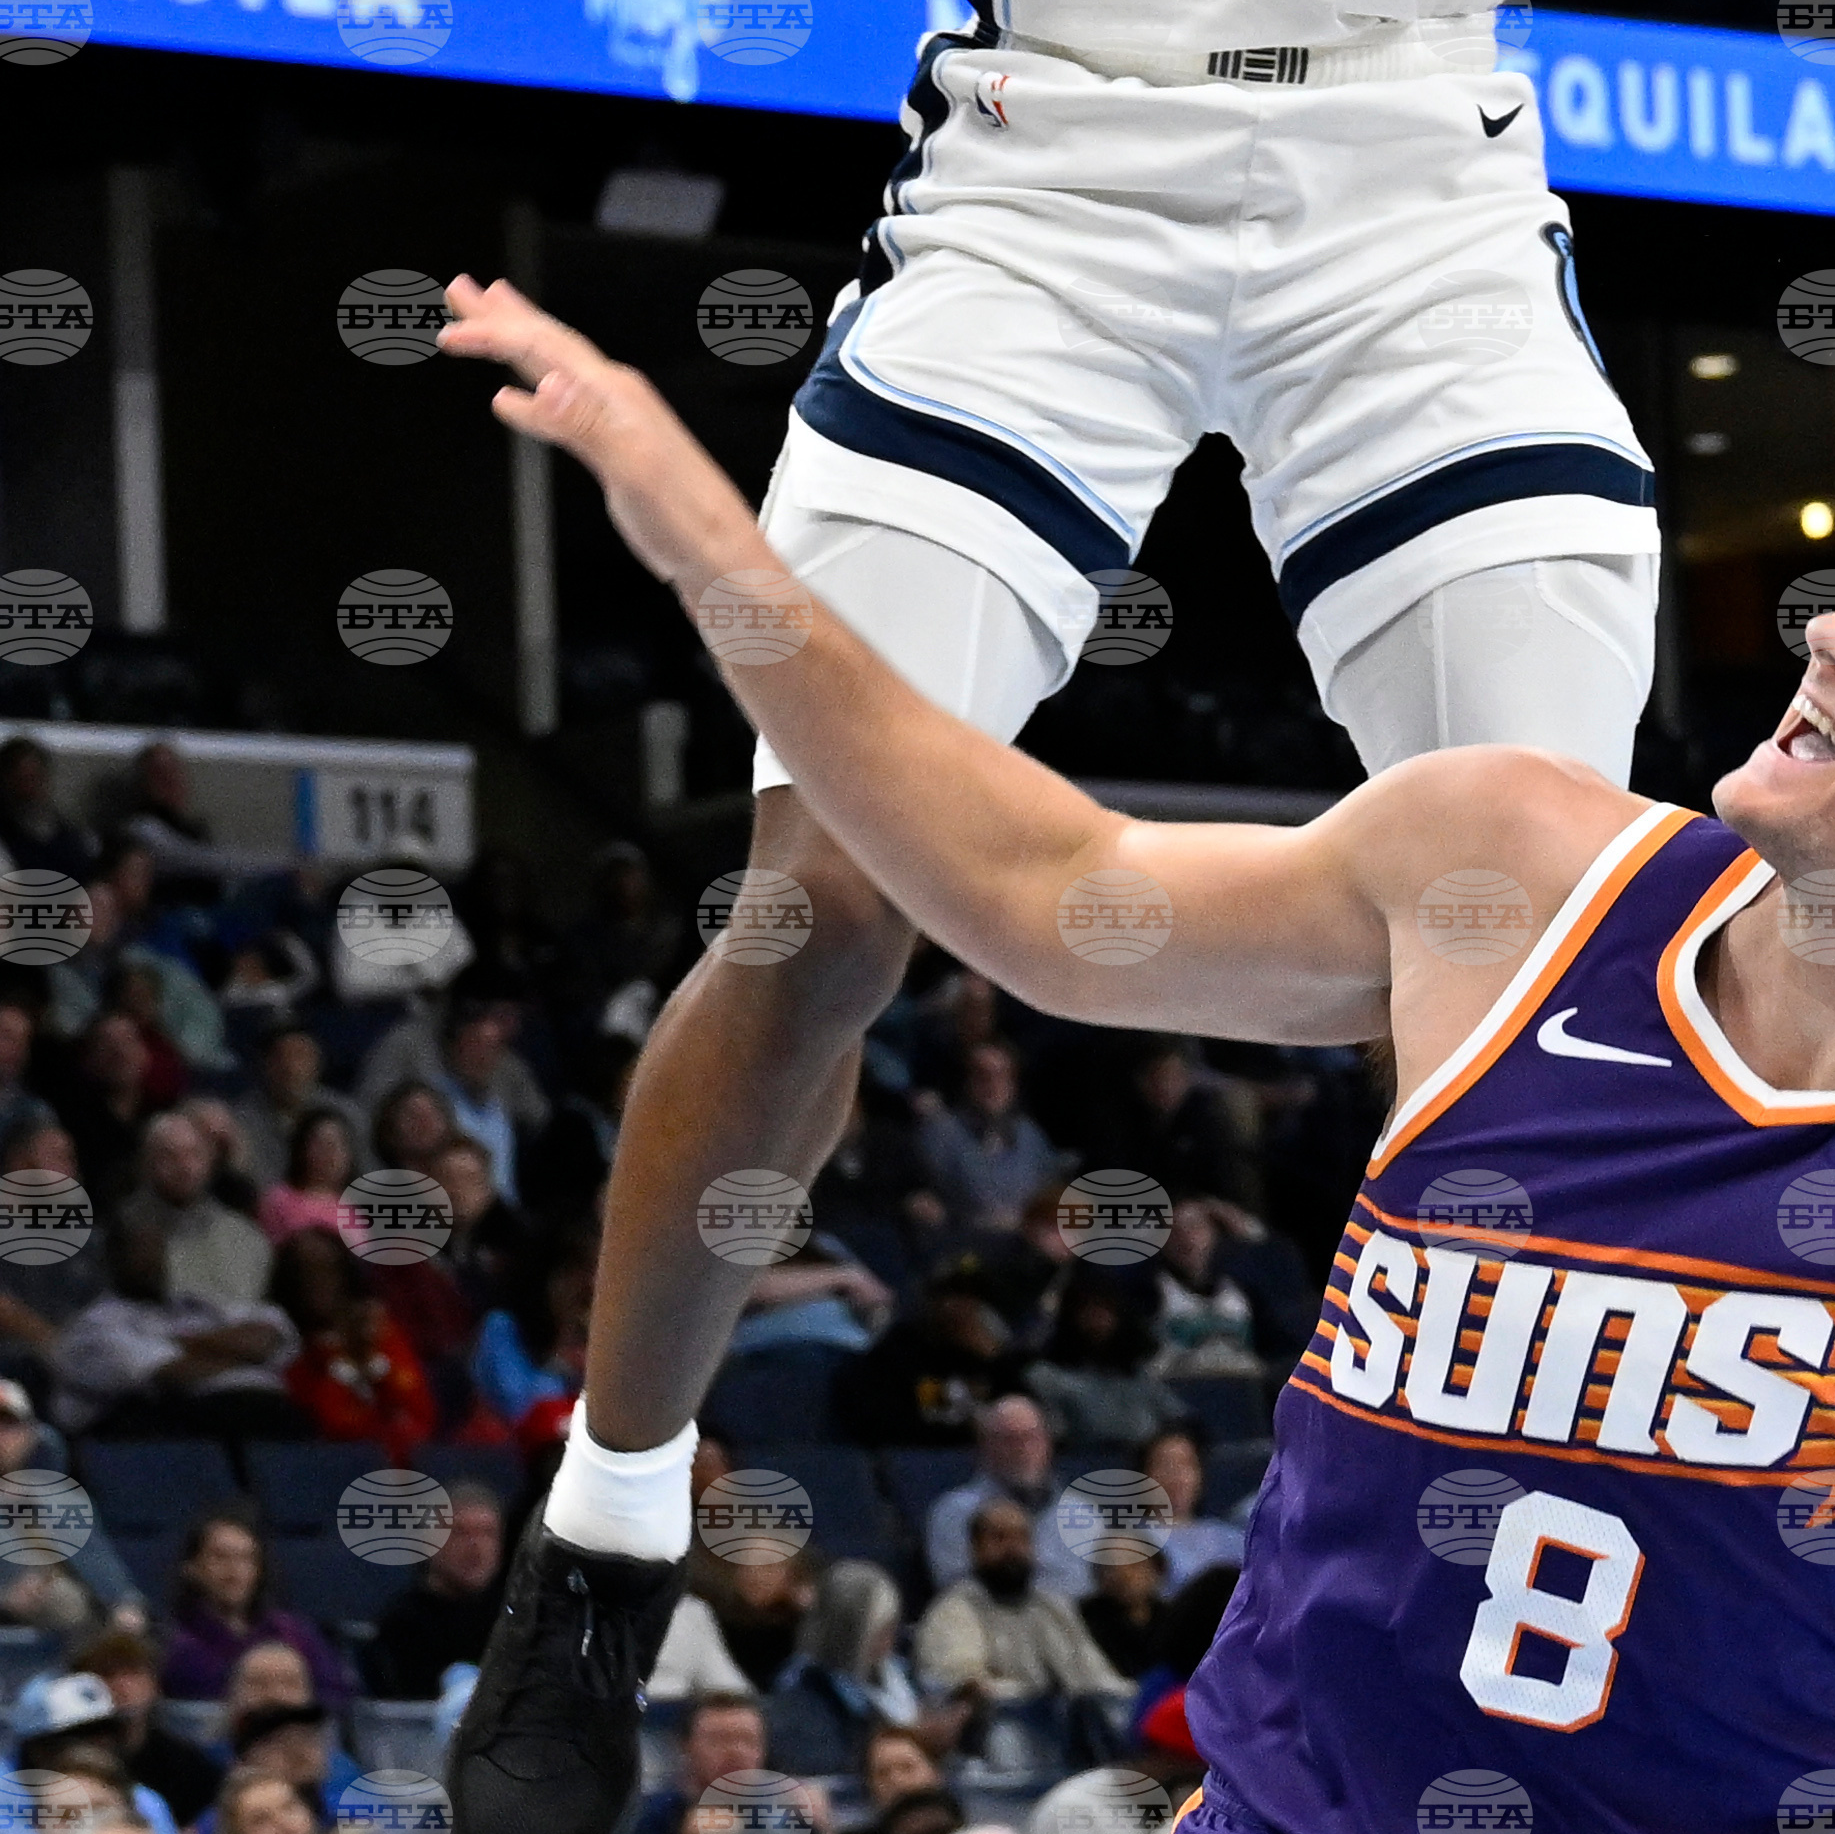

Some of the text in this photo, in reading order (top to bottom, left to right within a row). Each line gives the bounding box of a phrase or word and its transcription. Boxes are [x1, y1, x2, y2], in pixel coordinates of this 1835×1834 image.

[350, 784, 437, 843] 114
[1328, 1230, 1835, 1467] SUNS
[1458, 1489, 1646, 1734] 8
